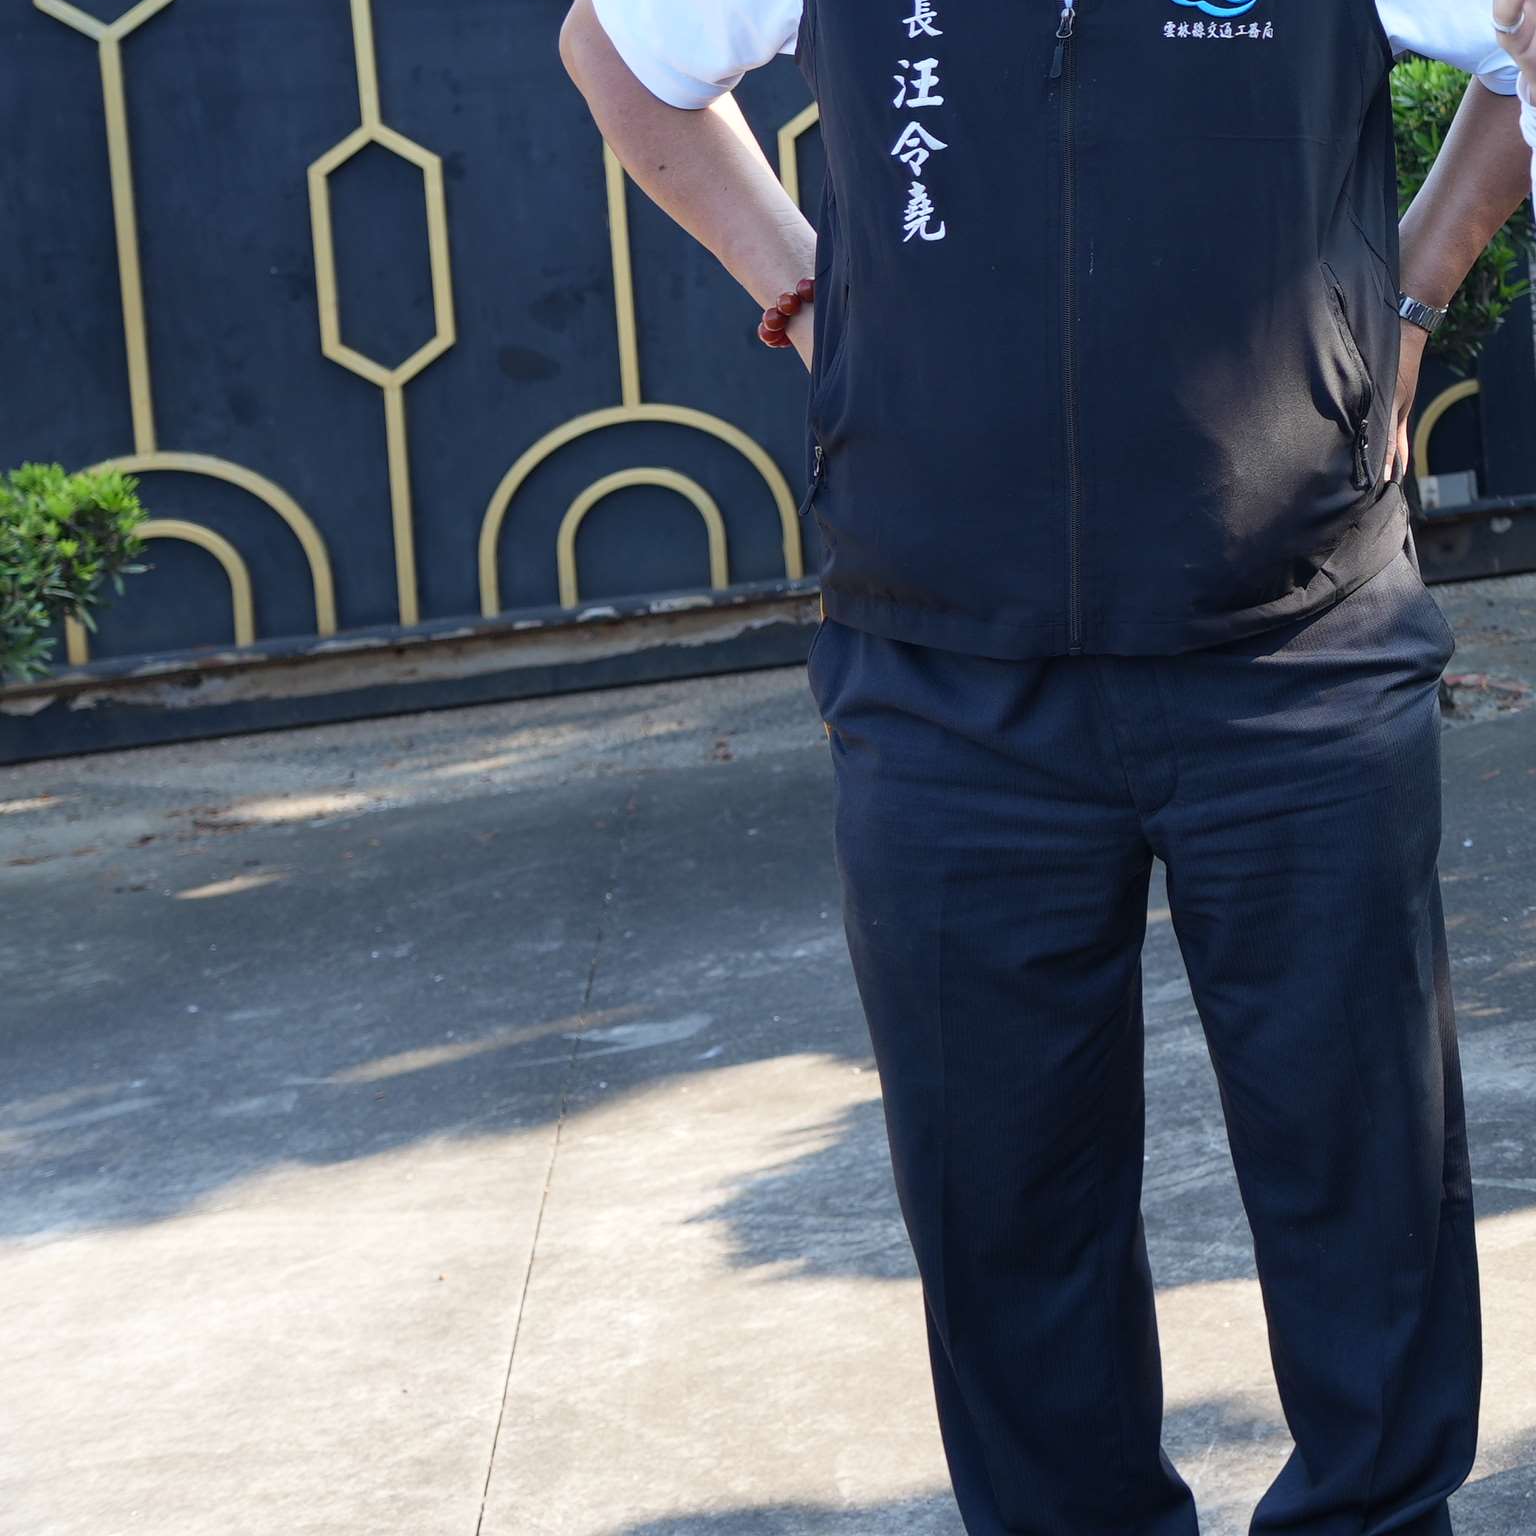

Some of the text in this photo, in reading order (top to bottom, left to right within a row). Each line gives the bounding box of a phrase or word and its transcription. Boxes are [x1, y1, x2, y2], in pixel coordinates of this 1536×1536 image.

[1163, 21, 1274, 39] 雲林縣交通工務局
